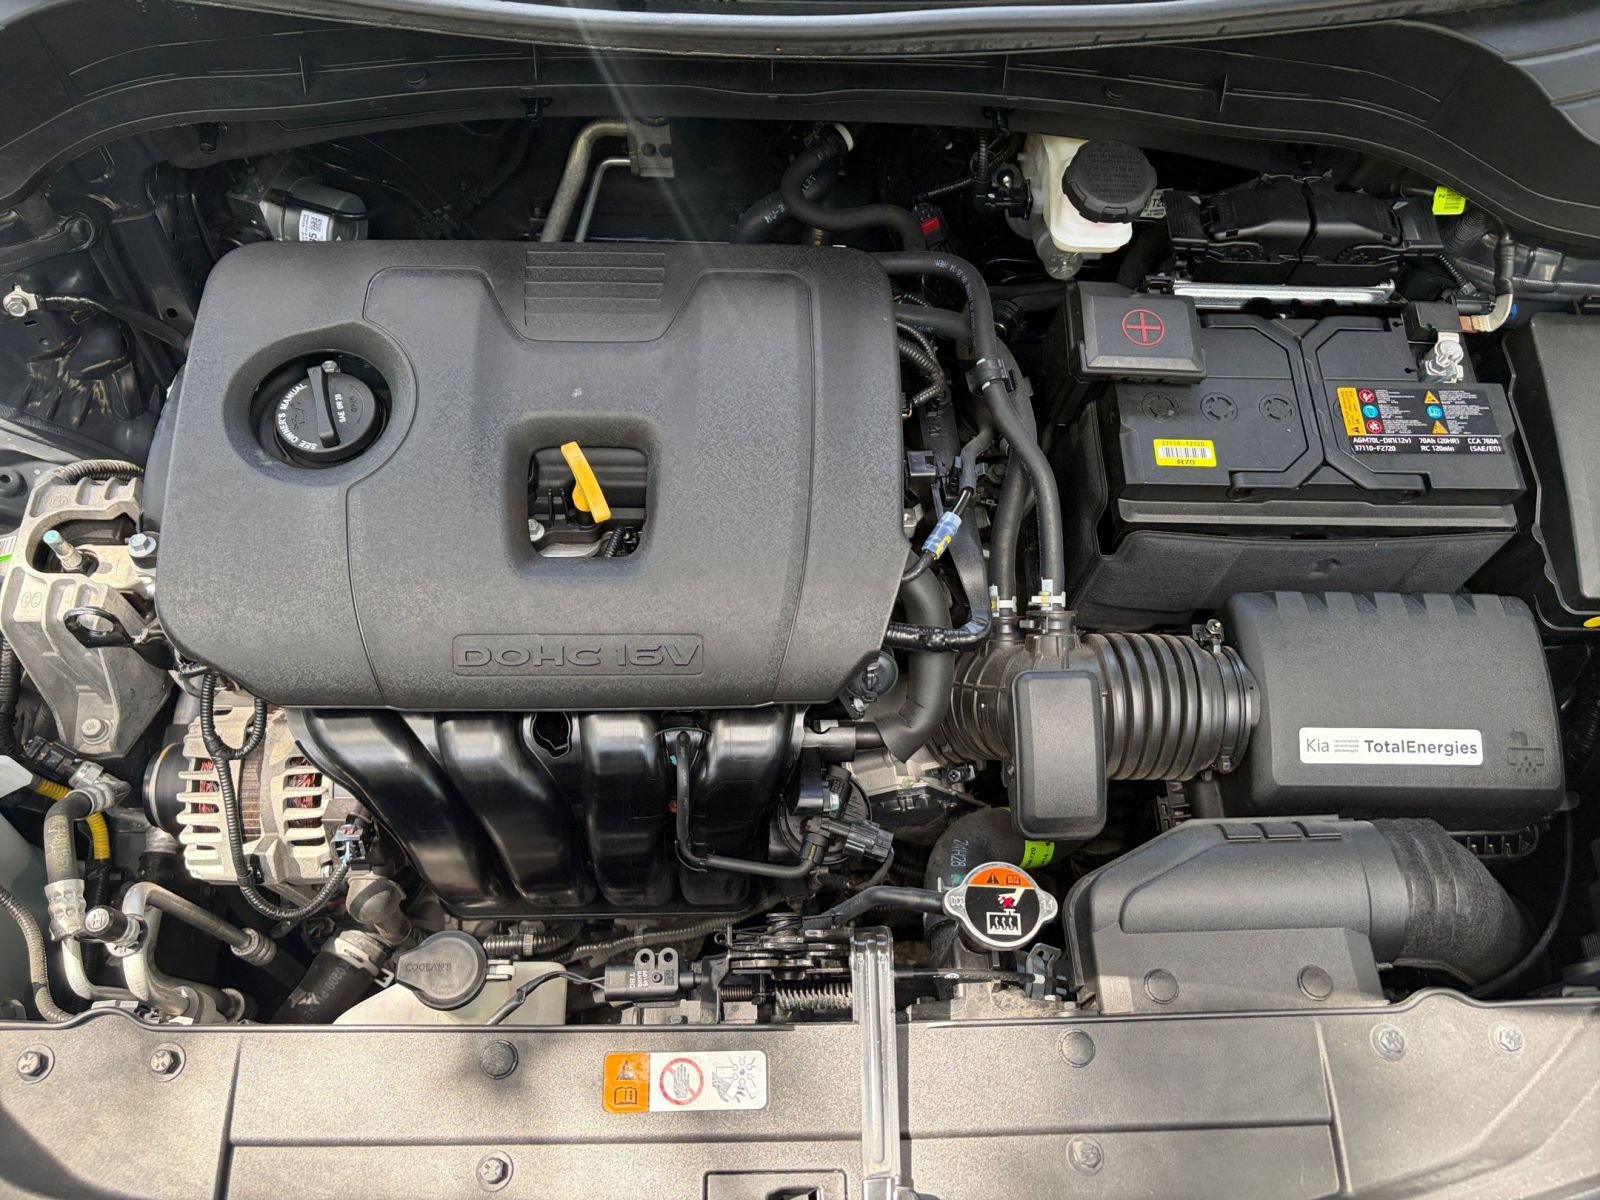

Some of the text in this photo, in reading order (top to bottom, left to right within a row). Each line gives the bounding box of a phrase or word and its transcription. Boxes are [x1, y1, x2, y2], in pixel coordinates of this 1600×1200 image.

[277, 383, 318, 451] SEE OWNER'S MANUAL
[338, 410, 346, 423] SAE
[456, 642, 700, 667] DOHC 16V
[1306, 738, 1330, 752] Kia
[1364, 740, 1478, 756] TotalEnergies
[406, 963, 452, 972] COOLANT
